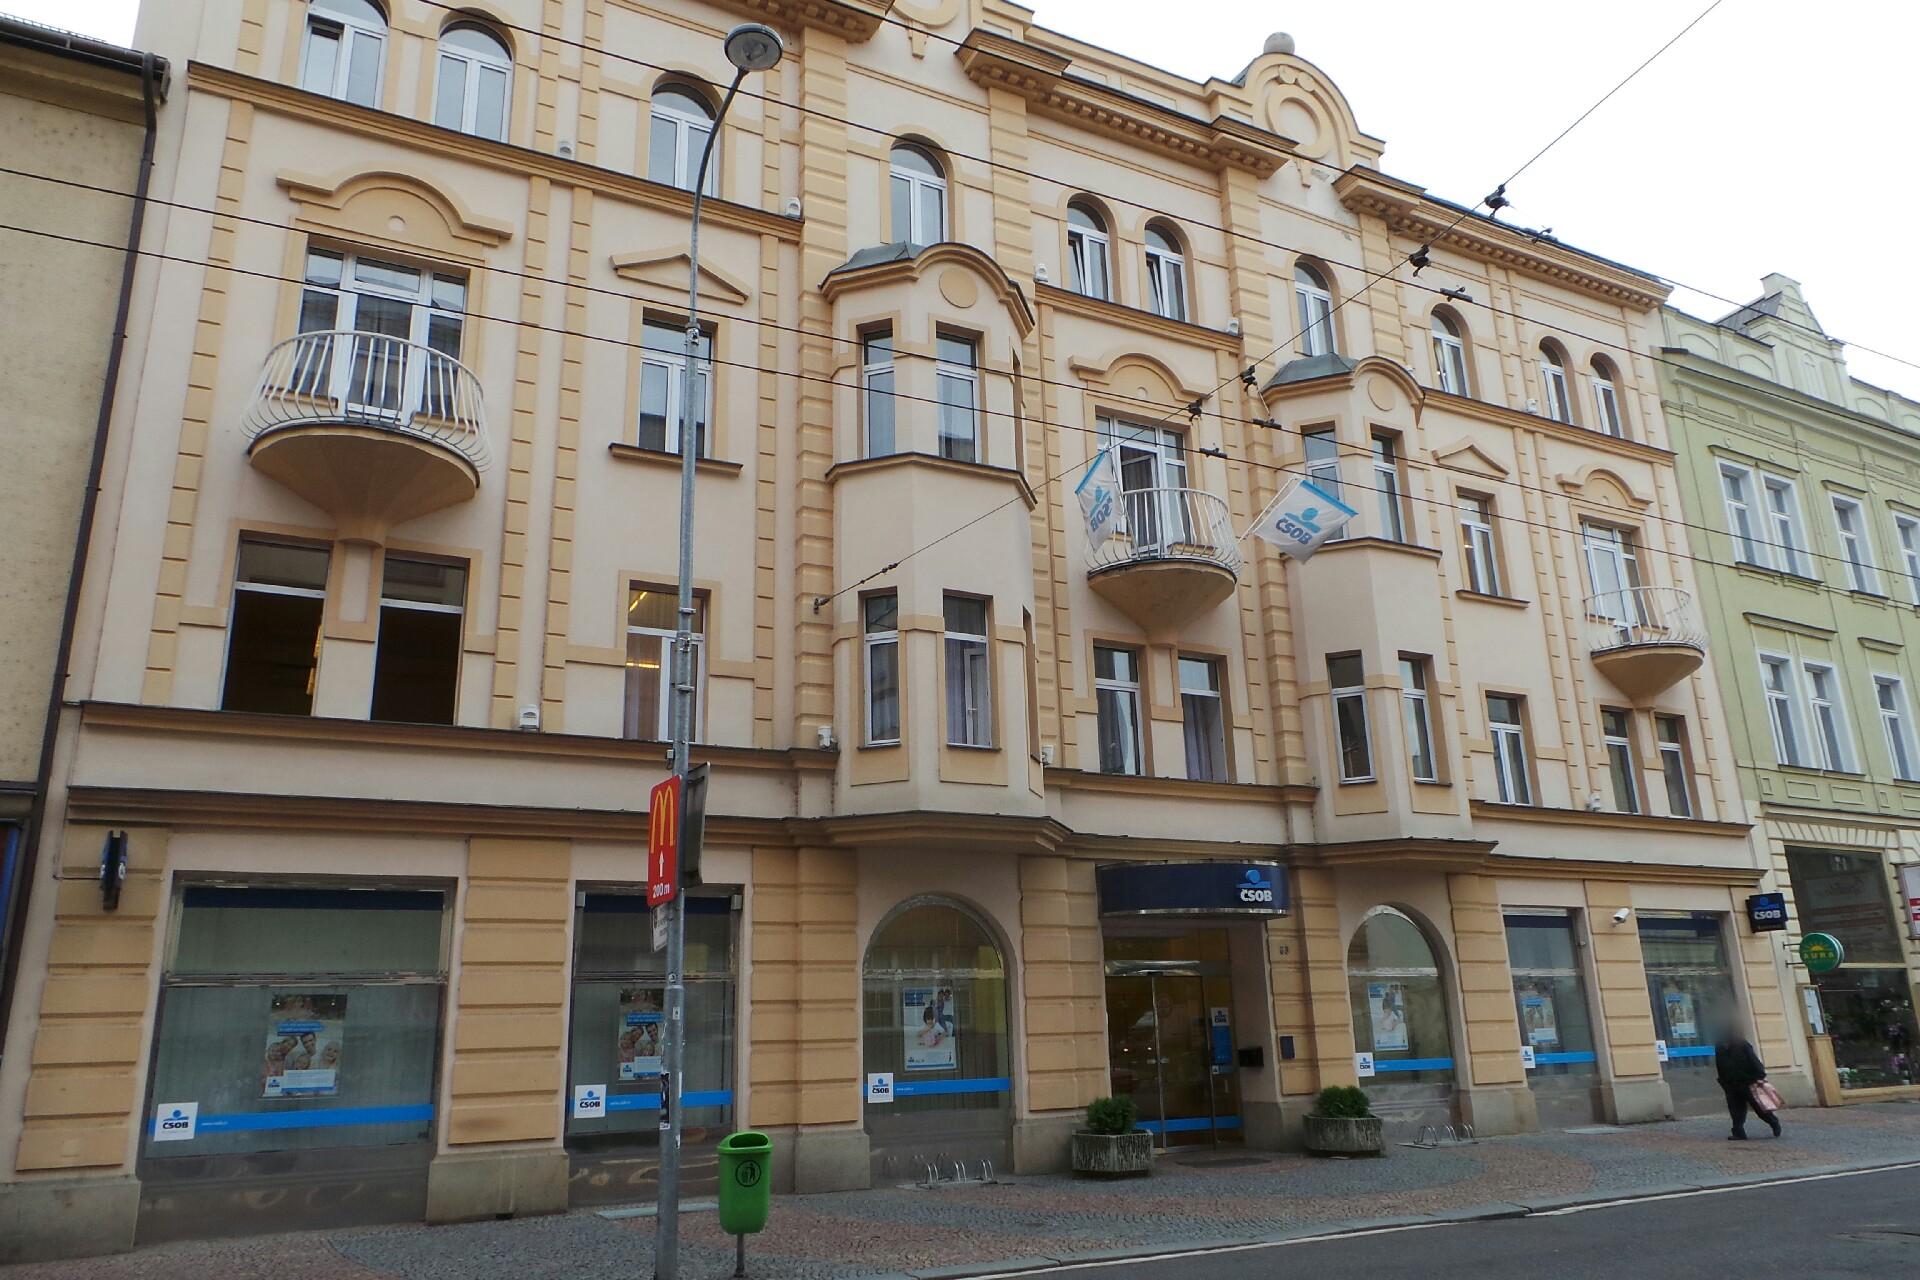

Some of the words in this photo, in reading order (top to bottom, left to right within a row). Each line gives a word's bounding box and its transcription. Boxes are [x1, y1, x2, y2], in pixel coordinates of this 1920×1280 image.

[1276, 518, 1312, 545] ČSOB
[652, 883, 664, 898] 200
[1240, 889, 1272, 902] ČSOB
[1754, 909, 1781, 920] ČSOB
